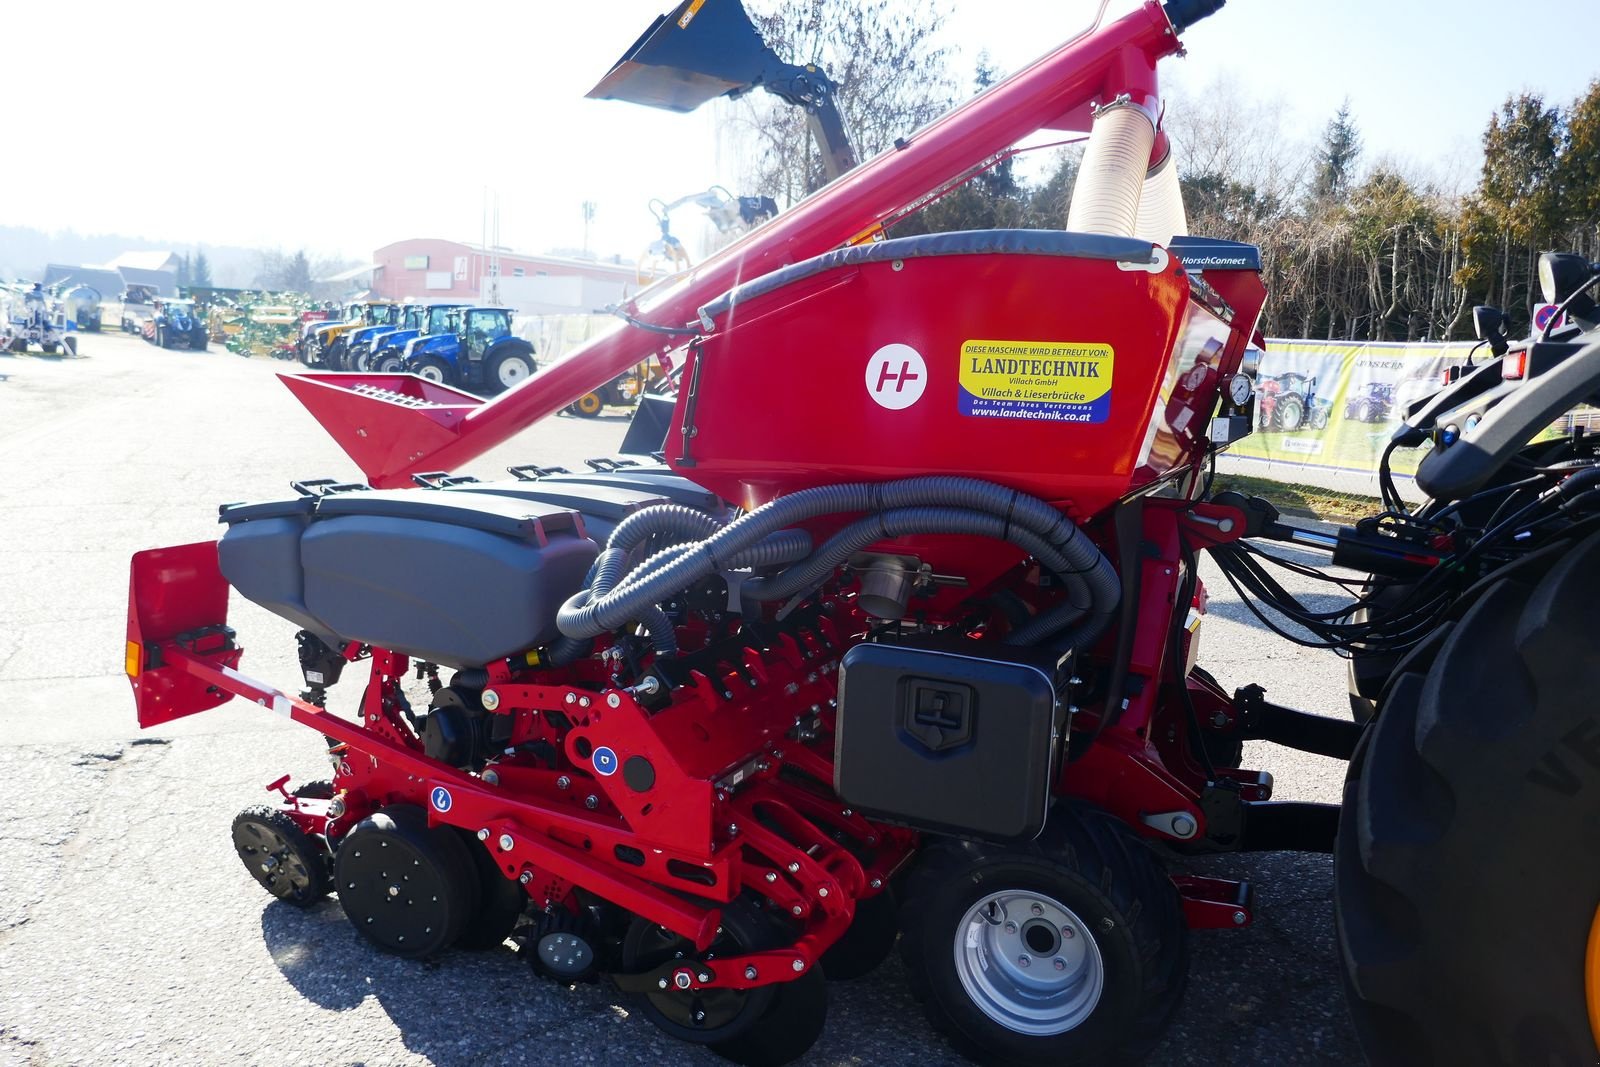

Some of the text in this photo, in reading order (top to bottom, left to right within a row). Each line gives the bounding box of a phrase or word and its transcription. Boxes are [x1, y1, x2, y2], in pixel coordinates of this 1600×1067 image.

[1181, 256, 1246, 265] HorschConnect
[987, 346, 1028, 354] MASCHINE
[1029, 347, 1051, 355] WIRD
[1051, 348, 1087, 356] BETREUT
[1088, 349, 1109, 357] VON:
[971, 357, 1099, 378] LANDTECHNIK
[1009, 377, 1033, 385] Villach
[981, 387, 1085, 400] Villach & Lieserbrücke
[1017, 401, 1039, 409] Ihres
[972, 408, 1091, 421] www.landtechnik.co.at
